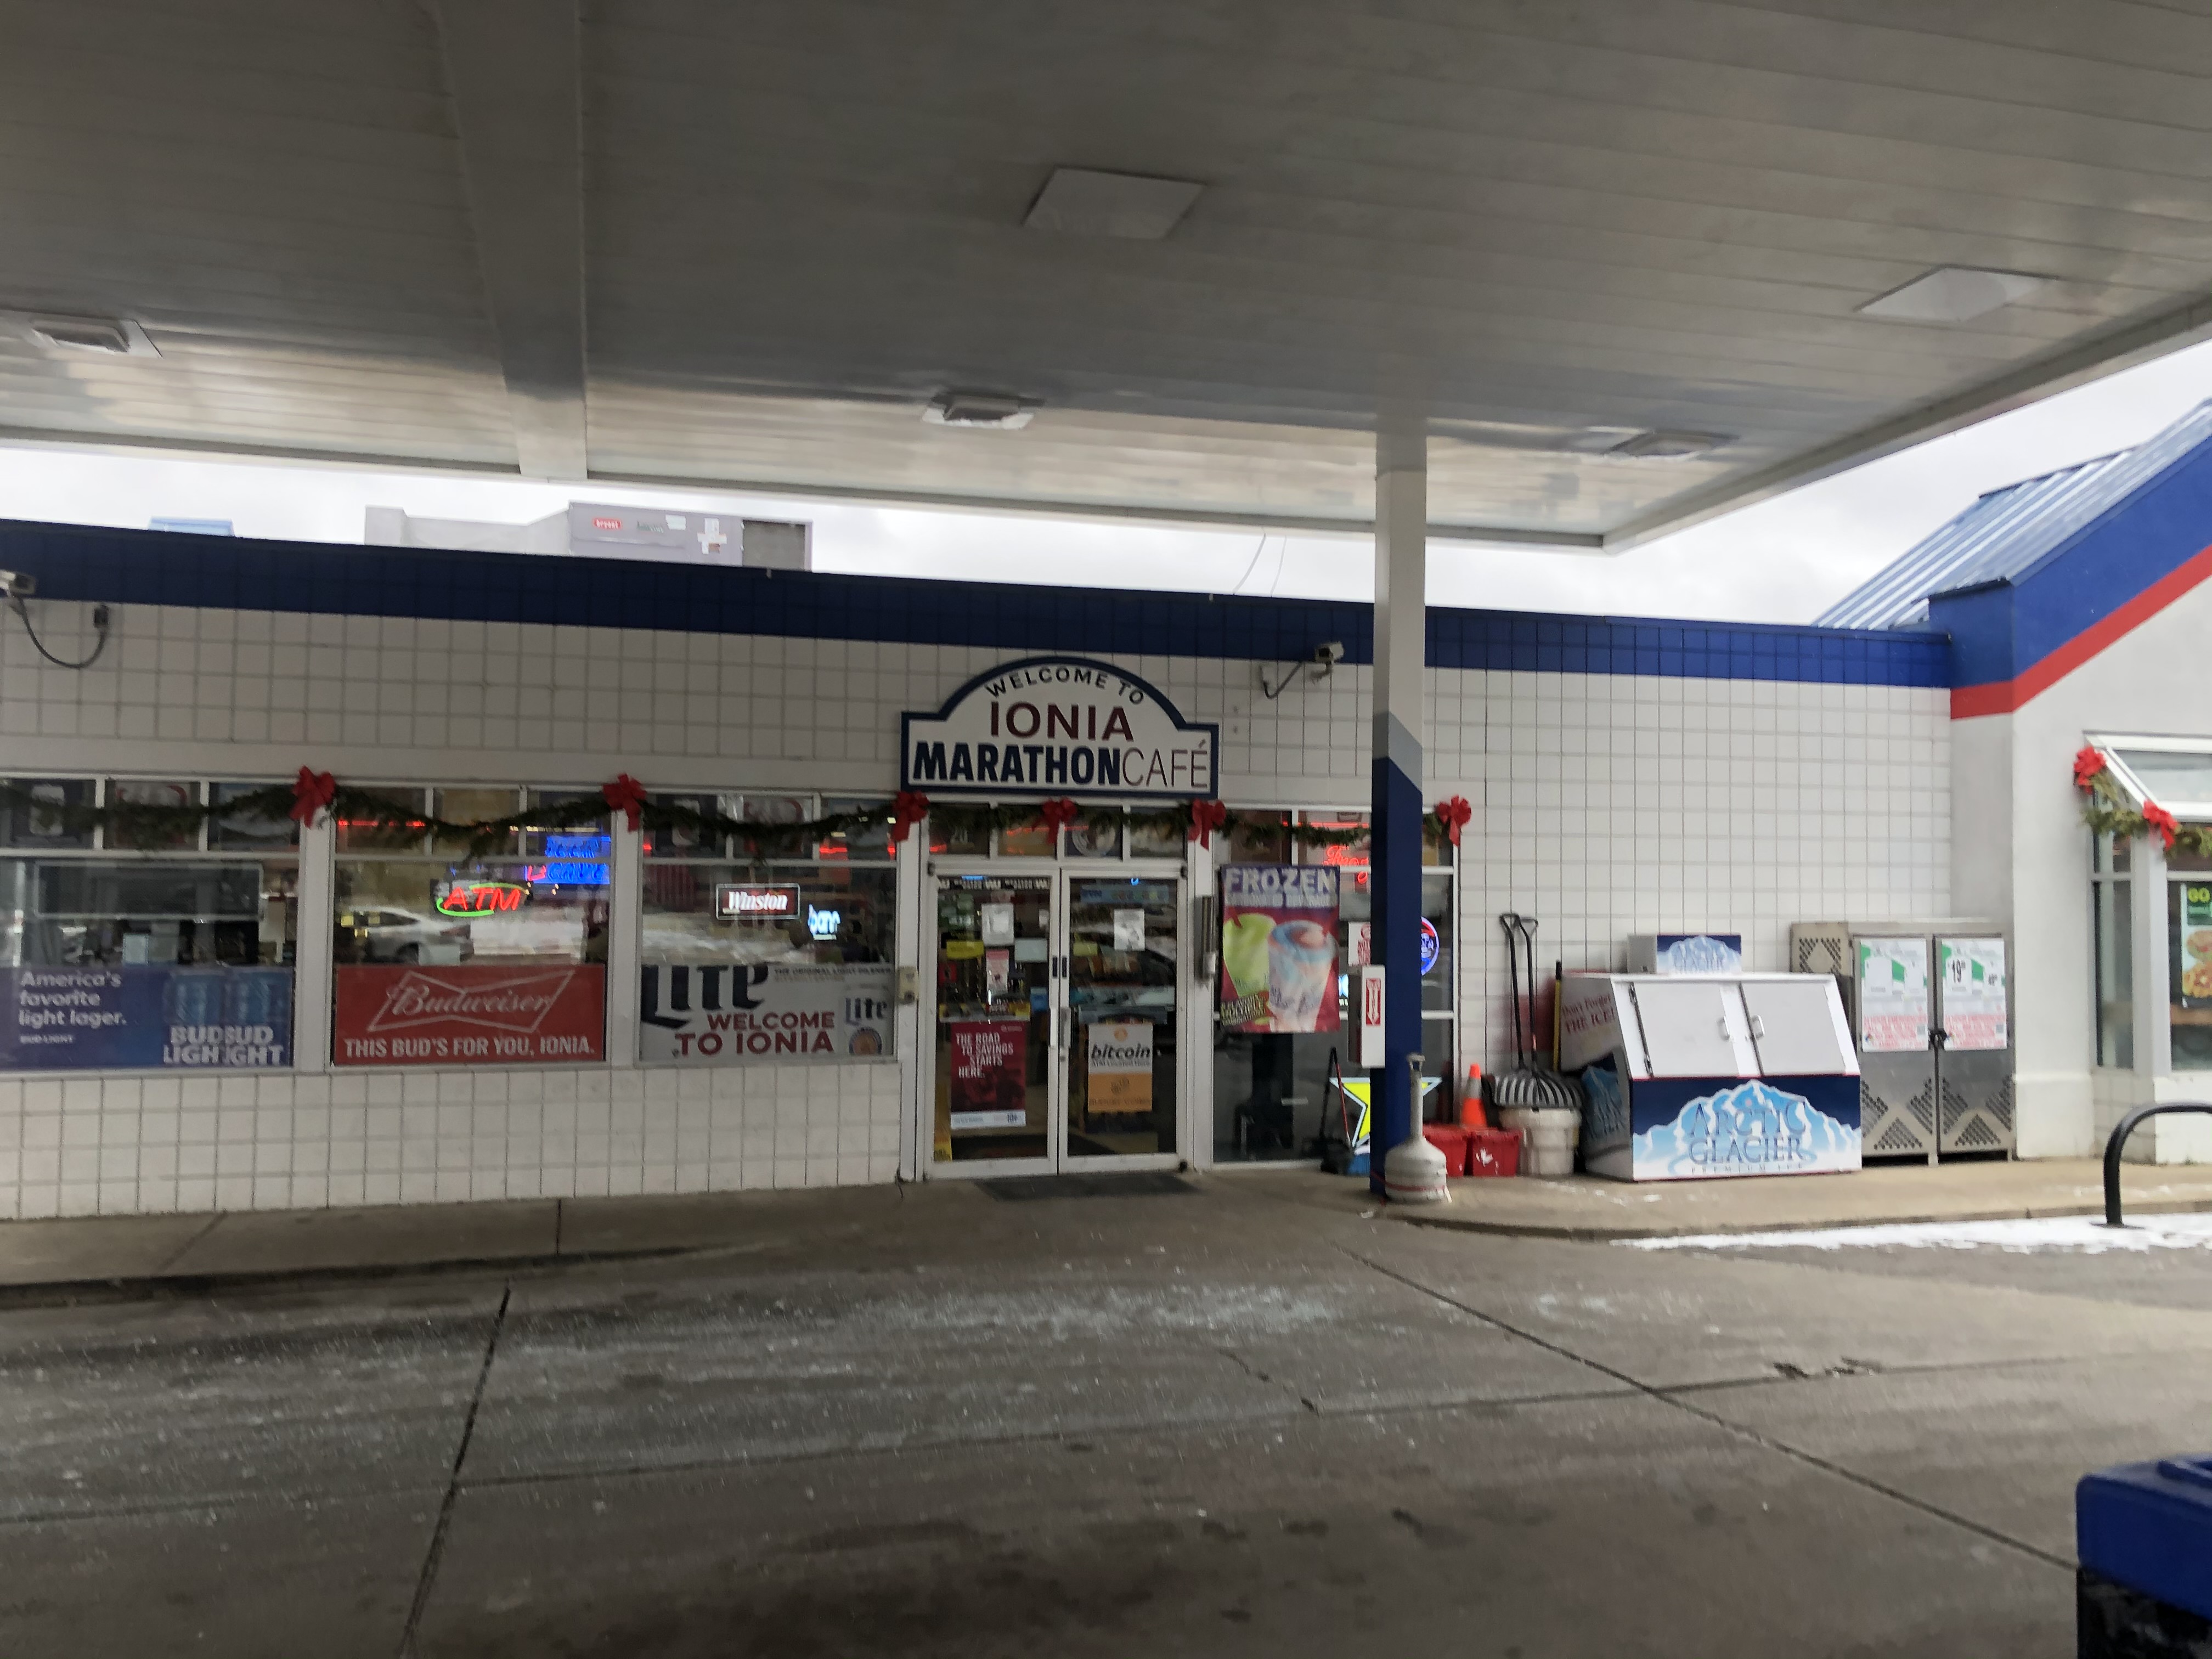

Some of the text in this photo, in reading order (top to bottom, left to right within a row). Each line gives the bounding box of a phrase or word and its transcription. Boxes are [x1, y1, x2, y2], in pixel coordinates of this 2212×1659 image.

[986, 665, 1145, 704] WELCOME TO
[991, 701, 1134, 742] IONIA
[1225, 868, 1338, 895] FROZEN
[443, 887, 521, 911] ATM
[729, 891, 788, 911] Winston
[21, 970, 122, 988] America's
[20, 990, 101, 1006] favorite
[385, 984, 552, 1016] Budweiser
[19, 1009, 127, 1029] light lager.
[707, 1012, 835, 1031] WELCOME
[171, 1025, 223, 1045] BUD
[675, 1030, 834, 1056] TO IONIA
[956, 1031, 1000, 1045] THE ROAD
[163, 1044, 220, 1064] LIGH
[345, 1036, 595, 1058] THIS BUD'S FOR YOU, IONIA.
[975, 1042, 1014, 1056] SAVINGS
[1091, 1042, 1150, 1059] bitcoin
[969, 1054, 1003, 1067] STARTS
[1688, 1101, 1807, 1137] ARCTIC
[1689, 1136, 1805, 1165] GLACIER
